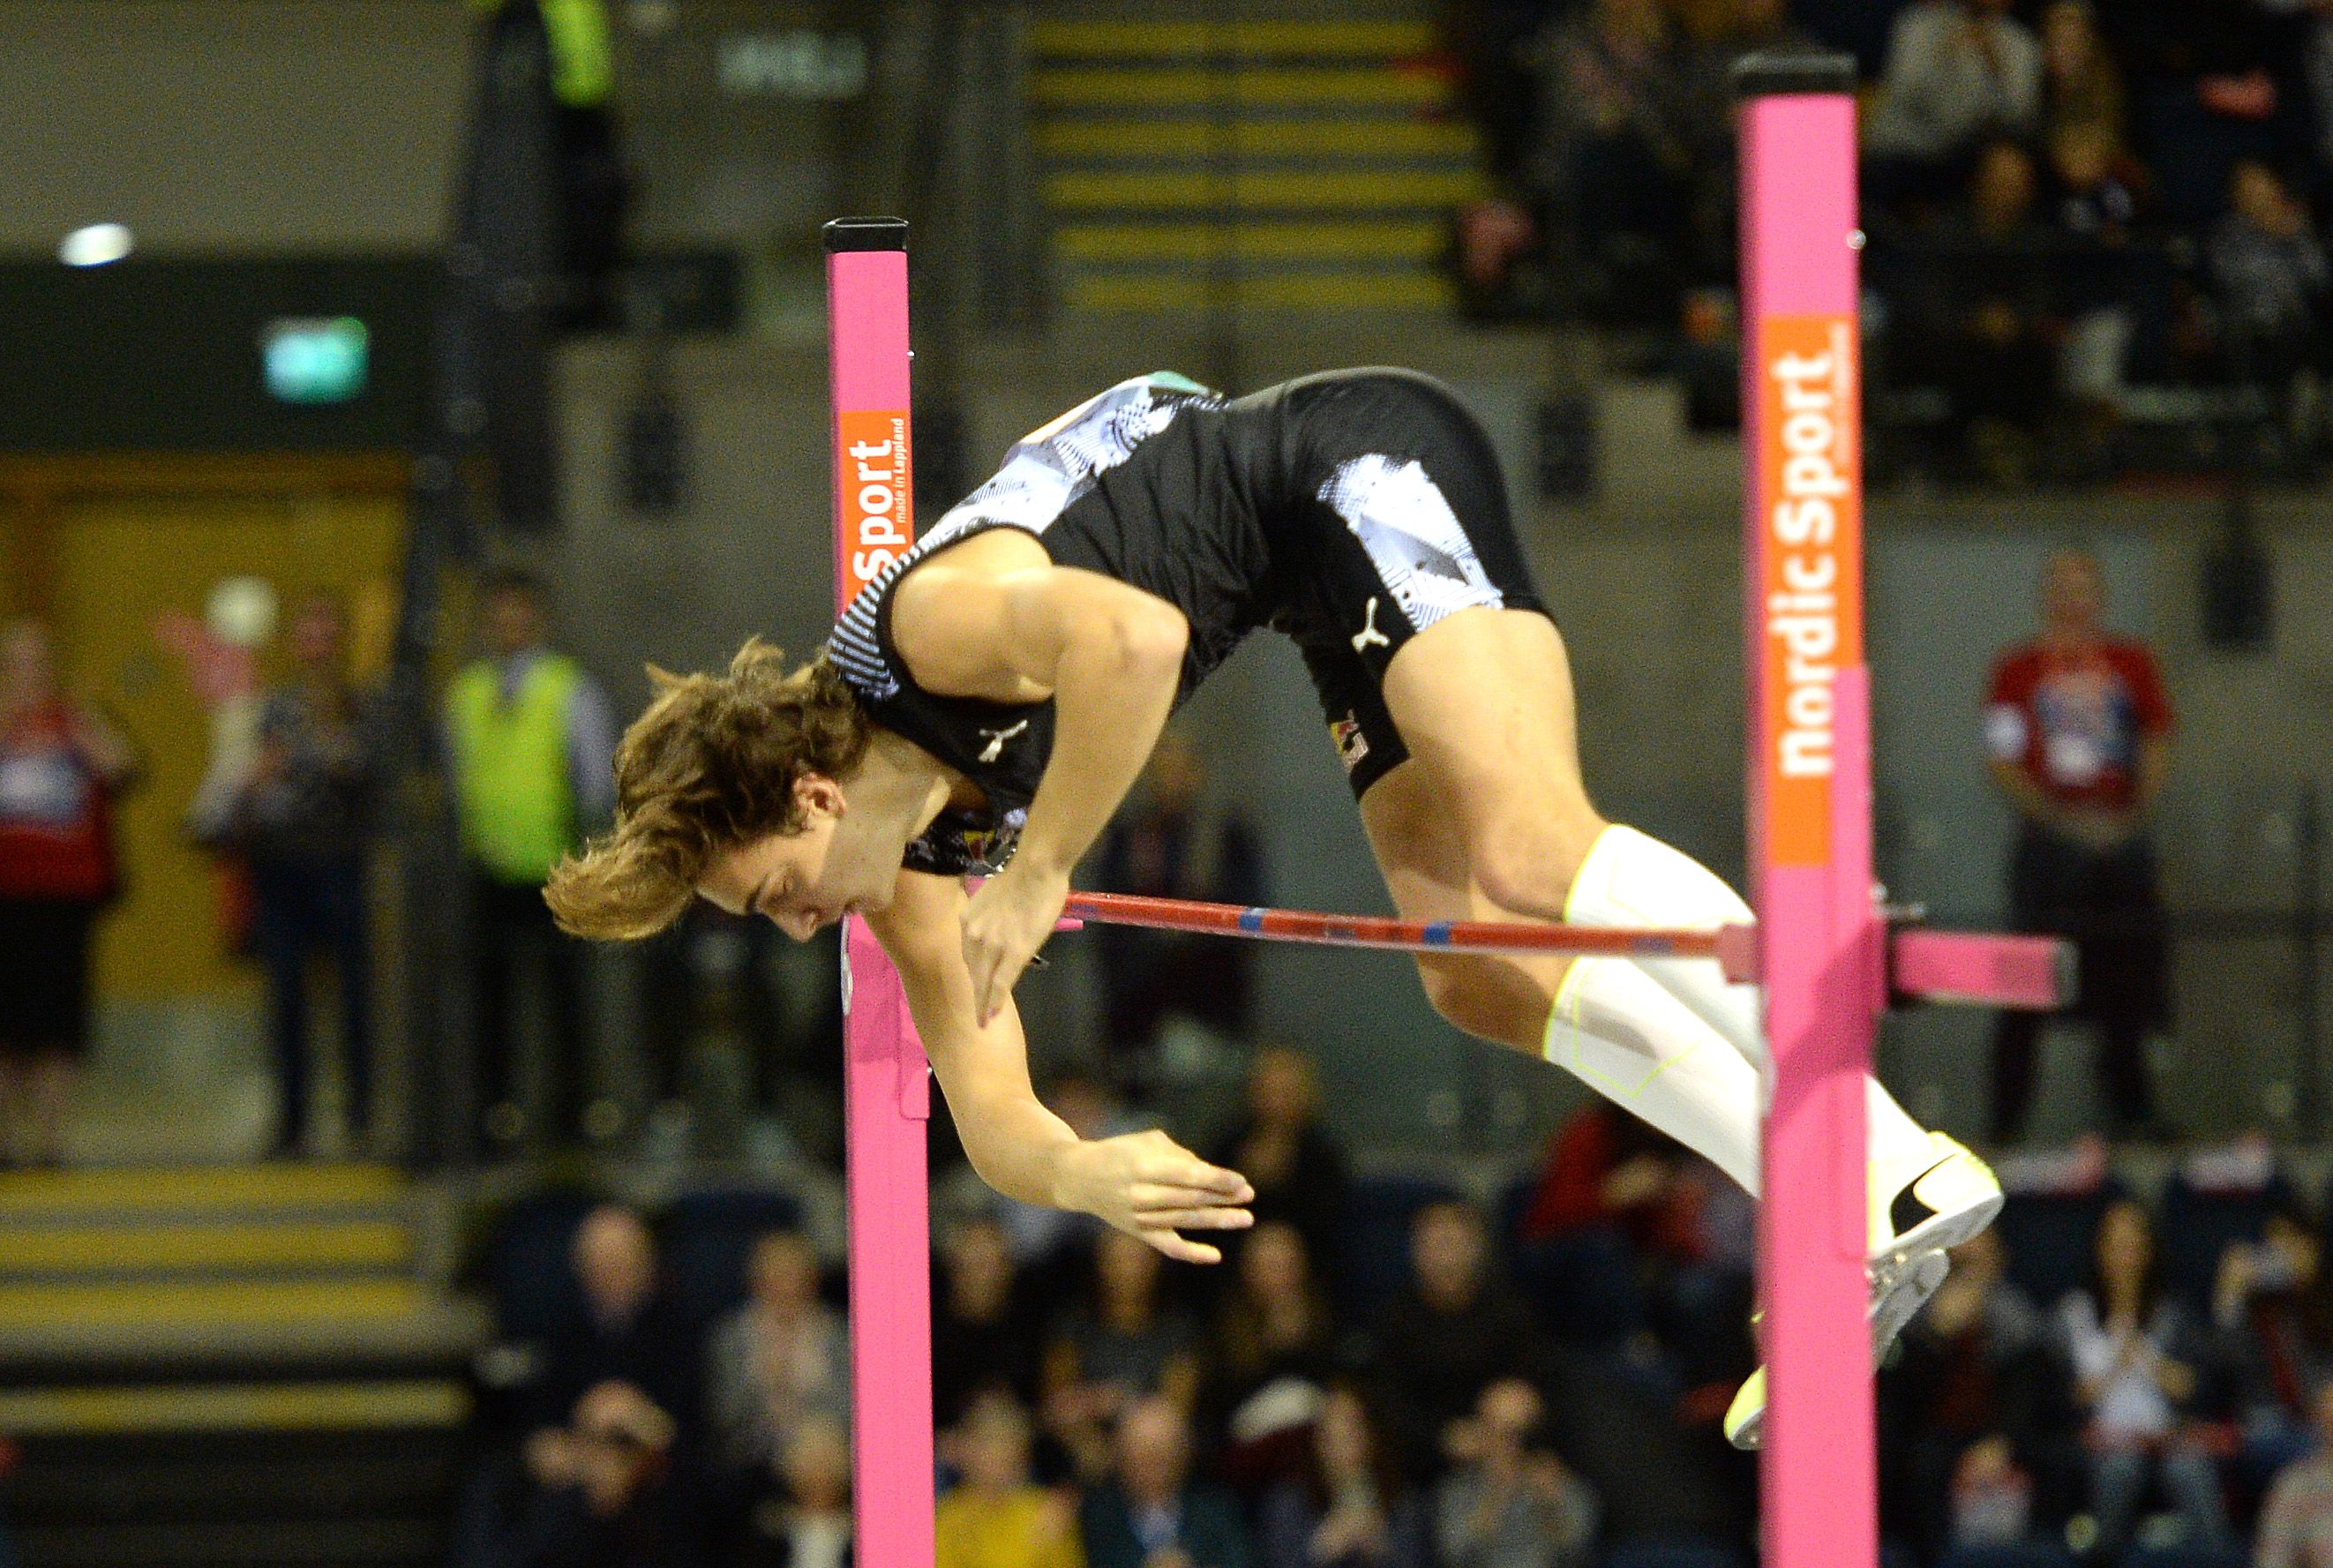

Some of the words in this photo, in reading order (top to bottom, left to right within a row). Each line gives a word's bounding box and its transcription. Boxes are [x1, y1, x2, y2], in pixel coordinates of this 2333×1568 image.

[891, 418, 907, 474] Lappland
[892, 476, 905, 490] in
[1771, 350, 1849, 544] Sport
[849, 440, 906, 581] Sport
[892, 491, 906, 523] made
[1768, 557, 1836, 777] nordic
